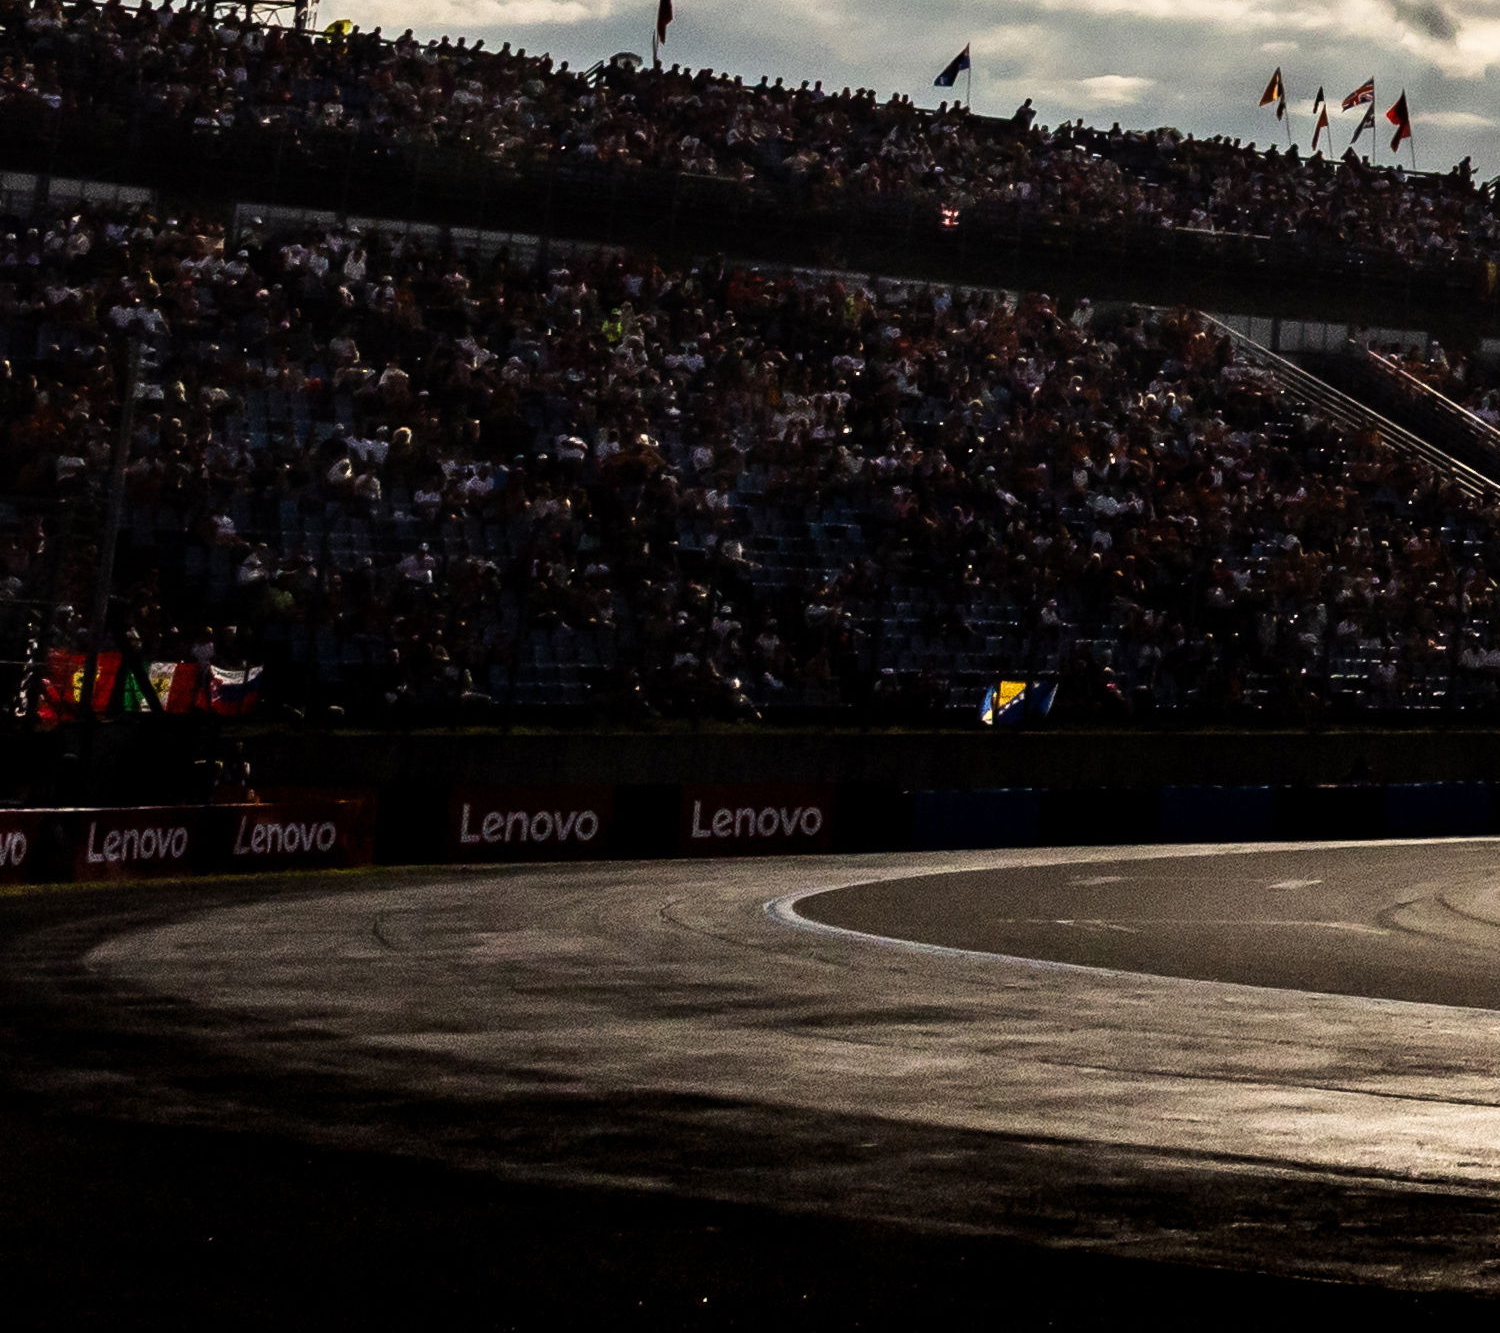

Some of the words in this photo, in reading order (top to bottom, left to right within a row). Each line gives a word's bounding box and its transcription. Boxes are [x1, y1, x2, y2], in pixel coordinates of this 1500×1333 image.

[232, 816, 337, 855] Lenovo
[459, 804, 599, 844] Lenovo
[691, 800, 823, 838] Lenovo
[87, 822, 188, 863] Lenovo
